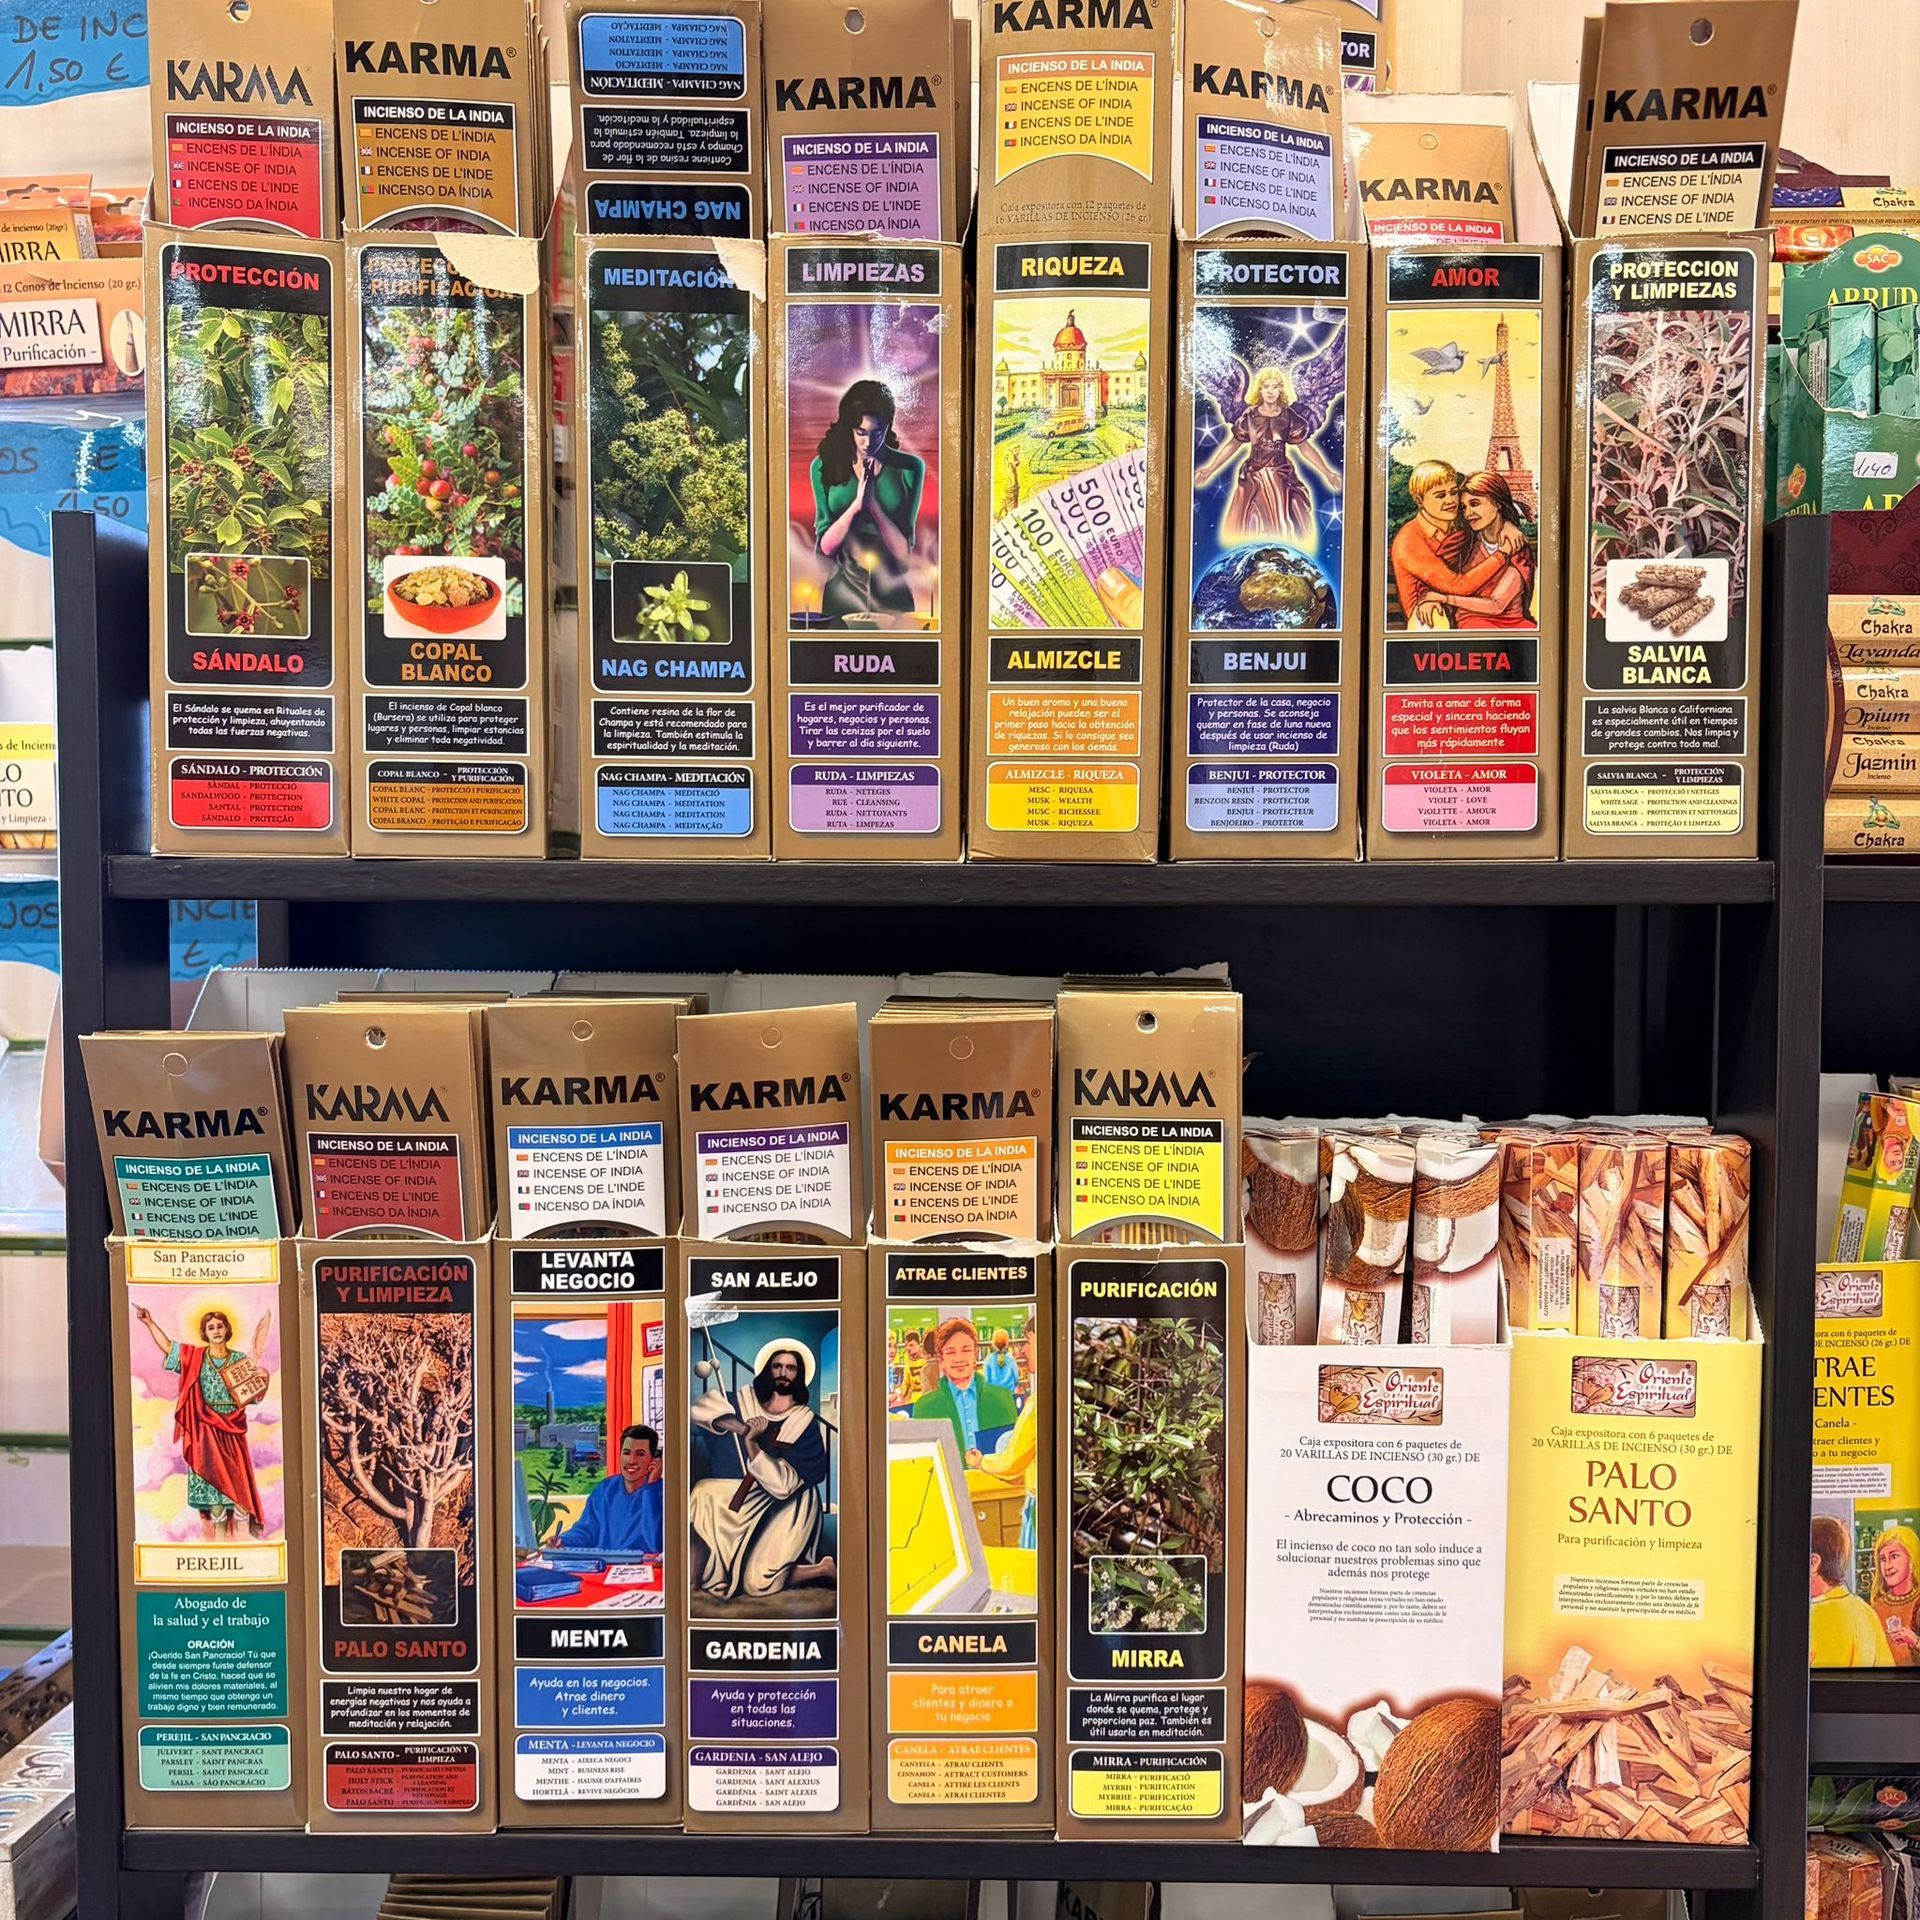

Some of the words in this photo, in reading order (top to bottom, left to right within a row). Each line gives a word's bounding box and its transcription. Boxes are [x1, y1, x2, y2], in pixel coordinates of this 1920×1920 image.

[12, 15, 62, 43] DE
[4, 49, 83, 92] 1,50
[364, 106, 424, 119] INCIENSO
[428, 108, 445, 120] DE
[450, 109, 466, 120] LA
[469, 110, 504, 123] INDIA
[375, 128, 427, 139] ENCENS
[431, 130, 448, 141] DE
[376, 147, 431, 158] INCENSE
[436, 148, 452, 159] OF
[457, 149, 491, 161] INDIA
[594, 199, 687, 219] CHAMPA
[695, 201, 741, 220] NAG
[1873, 198, 1915, 208] Chakra
[13, 224, 44, 232] incienso
[1021, 256, 1125, 277] RIQUEZA
[1867, 254, 1888, 264] SAC
[170, 258, 320, 291] PROTECCIÓN
[802, 262, 925, 284] LIMPIEZAS
[1432, 268, 1499, 287] AMOR
[1610, 261, 1739, 280] PROTECCION
[3, 285, 12, 293] 12
[15, 282, 45, 292] Conos
[64, 279, 104, 290] Incienso
[109, 279, 123, 289] (20
[126, 279, 140, 291] gr.)
[1611, 285, 1624, 300] Y
[1631, 283, 1737, 299] LIMPIEZAS
[4, 345, 86, 362] Purificación
[1861, 619, 1912, 636] Chakra
[192, 649, 303, 673] SÁNDALO
[410, 643, 482, 662] COPAL
[1008, 651, 1121, 670] ALMIZCLE
[1224, 652, 1306, 671] BENJUI
[1414, 652, 1511, 671] VIOLETA
[1628, 645, 1706, 663] SALVIA
[401, 663, 492, 683] BLANCO
[602, 659, 647, 678] NAG
[654, 660, 746, 679] CHAMPA
[834, 655, 895, 673] RUDA
[1623, 667, 1712, 684] BLANCA
[1857, 684, 1909, 700] Chakra
[805, 702, 816, 712] Es
[819, 702, 826, 712] el
[829, 702, 855, 715] mejor
[859, 702, 910, 715] purificador
[913, 703, 925, 712] de
[1843, 706, 1910, 728] Opium
[1852, 737, 1906, 747] Chakra
[1854, 833, 1904, 848] Chakra
[126, 1163, 182, 1176] INCIENSO
[185, 1164, 202, 1176] DE
[206, 1163, 223, 1175] LA
[226, 1162, 261, 1174] INDIA
[154, 1250, 177, 1264] San
[181, 1250, 245, 1266] Pancracio
[541, 1252, 634, 1268] LEVANTA
[171, 1268, 182, 1277] 12
[185, 1267, 197, 1277] de
[200, 1267, 228, 1280] Mayo
[321, 1262, 468, 1282] PURIFICACIÓN
[541, 1273, 635, 1289] NEGOCIO
[711, 1272, 749, 1288] SAN
[756, 1272, 818, 1288] ALEJO
[896, 1268, 946, 1281] ATRAE
[952, 1266, 1028, 1280] CLIENTES
[1081, 1279, 1217, 1298] PURIFICACIÓN
[1838, 1273, 1879, 1292] Oriente
[337, 1289, 349, 1303] Y
[357, 1287, 453, 1303] LIMPIEZA
[1820, 1291, 1879, 1310] Espiritual
[1386, 1370, 1439, 1393] Oriente
[1640, 1363, 1692, 1386] Oriente
[1364, 1390, 1438, 1413] Espiritual
[1616, 1381, 1692, 1406] Espiritual
[1815, 1418, 1850, 1428] Canela
[1299, 1436, 1321, 1447] Caja
[1323, 1438, 1374, 1450] expositora
[1377, 1440, 1394, 1448] con
[1397, 1440, 1403, 1448] 6
[1405, 1440, 1447, 1451] paquetes
[1450, 1440, 1462, 1449] de
[1280, 1449, 1292, 1458] 20
[1295, 1449, 1348, 1461] VARILLAS
[1351, 1451, 1367, 1461] DE
[1370, 1451, 1424, 1462] INCIENSO
[1427, 1452, 1443, 1463] (30
[1446, 1452, 1462, 1464] gr.)
[1465, 1452, 1480, 1462] DE
[1586, 1461, 1676, 1490] PALO
[1327, 1475, 1433, 1504] COCO
[1293, 1509, 1379, 1524] Abrecaminos
[1383, 1515, 1390, 1527] y
[1395, 1512, 1462, 1525] Protección
[1569, 1496, 1692, 1527] SANTO
[1558, 1533, 1581, 1544] Para
[1583, 1535, 1646, 1548] purificación
[1650, 1540, 1656, 1550] y
[1658, 1538, 1702, 1550] limpieza
[176, 1557, 243, 1571] PEREJIL
[174, 1597, 228, 1611] Abogado
[231, 1598, 247, 1609] de
[153, 1615, 162, 1626] la
[165, 1614, 199, 1626] salud
[202, 1617, 209, 1629] y
[212, 1614, 224, 1626] el
[227, 1614, 270, 1628] trabajo
[187, 1637, 235, 1649] ORACIÓN
[551, 1630, 628, 1648] MENTA
[918, 1635, 1008, 1654] CANELA
[335, 1641, 387, 1659] PALO
[395, 1641, 467, 1658] SANTO
[706, 1641, 822, 1659] GARDENIA
[1112, 1650, 1184, 1668] MIRRA
[530, 1677, 563, 1689] Ayuda
[567, 1679, 579, 1688] en
[582, 1677, 597, 1688] los
[555, 1691, 588, 1701] Atrae
[591, 1691, 625, 1702] dinero
[562, 1707, 569, 1717] y
